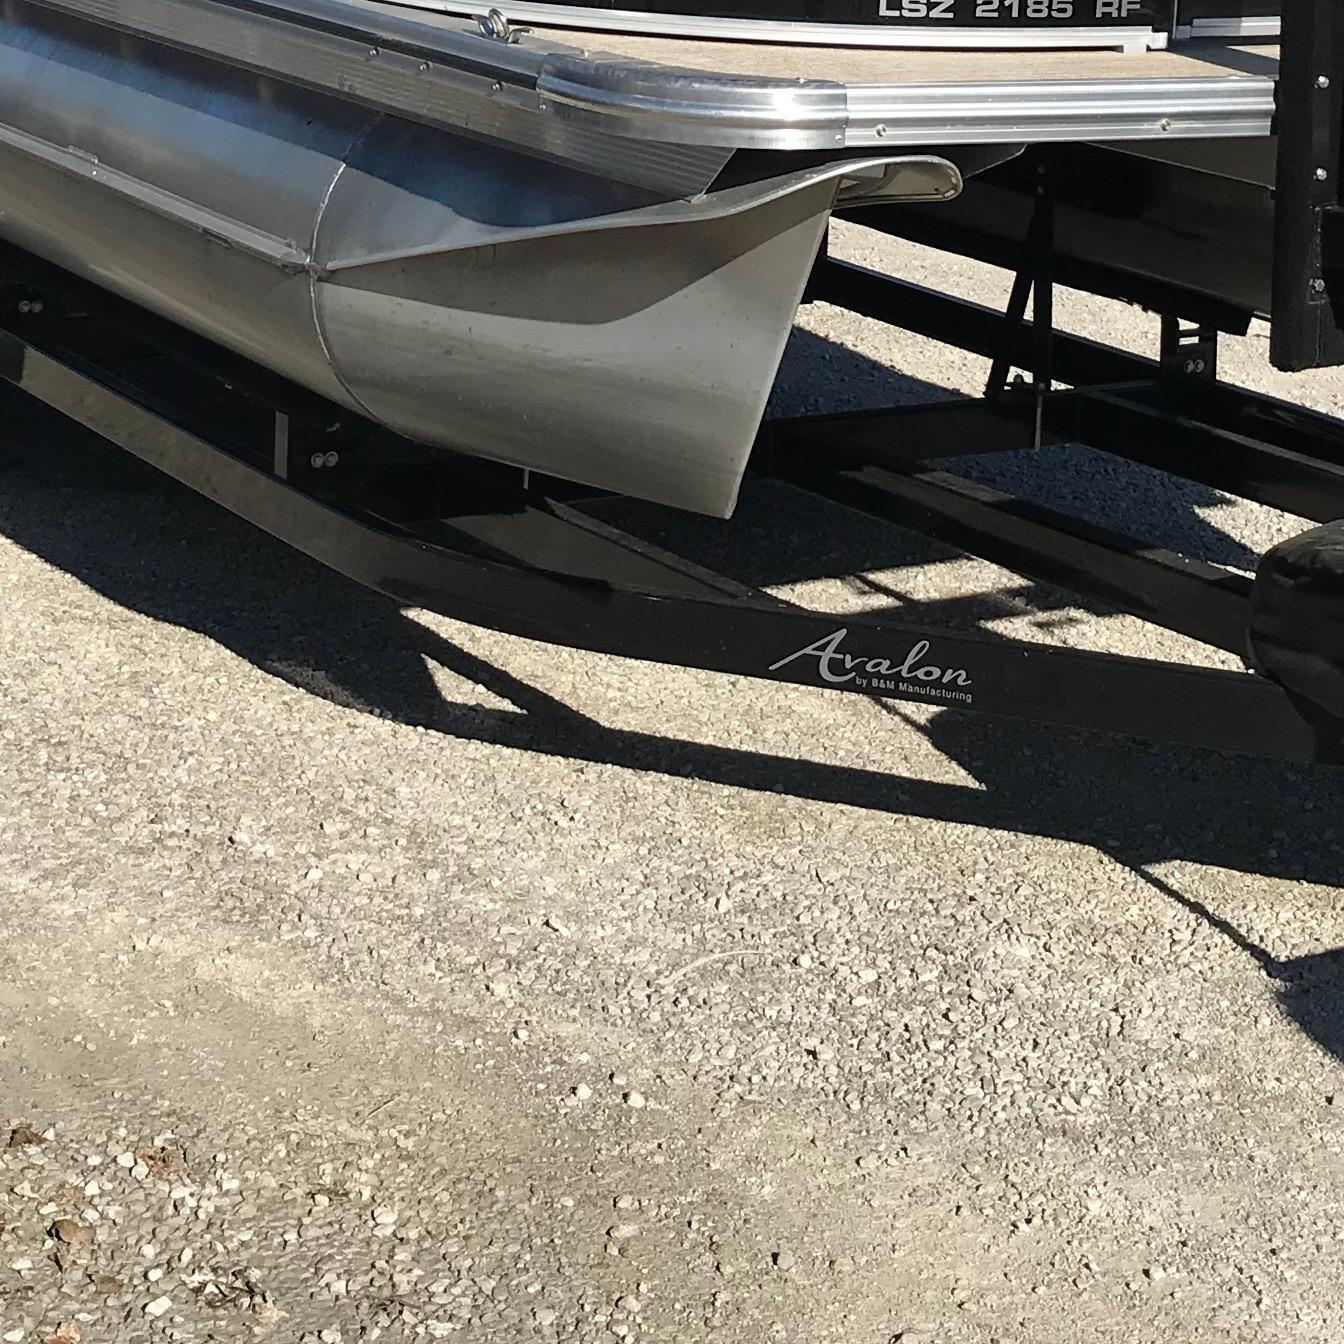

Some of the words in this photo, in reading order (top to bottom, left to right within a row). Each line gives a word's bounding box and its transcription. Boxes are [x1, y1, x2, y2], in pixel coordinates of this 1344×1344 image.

[768, 628, 972, 685] Avalon
[856, 676, 867, 687] by
[871, 678, 895, 690] B&M
[898, 682, 973, 703] Manufacturing
